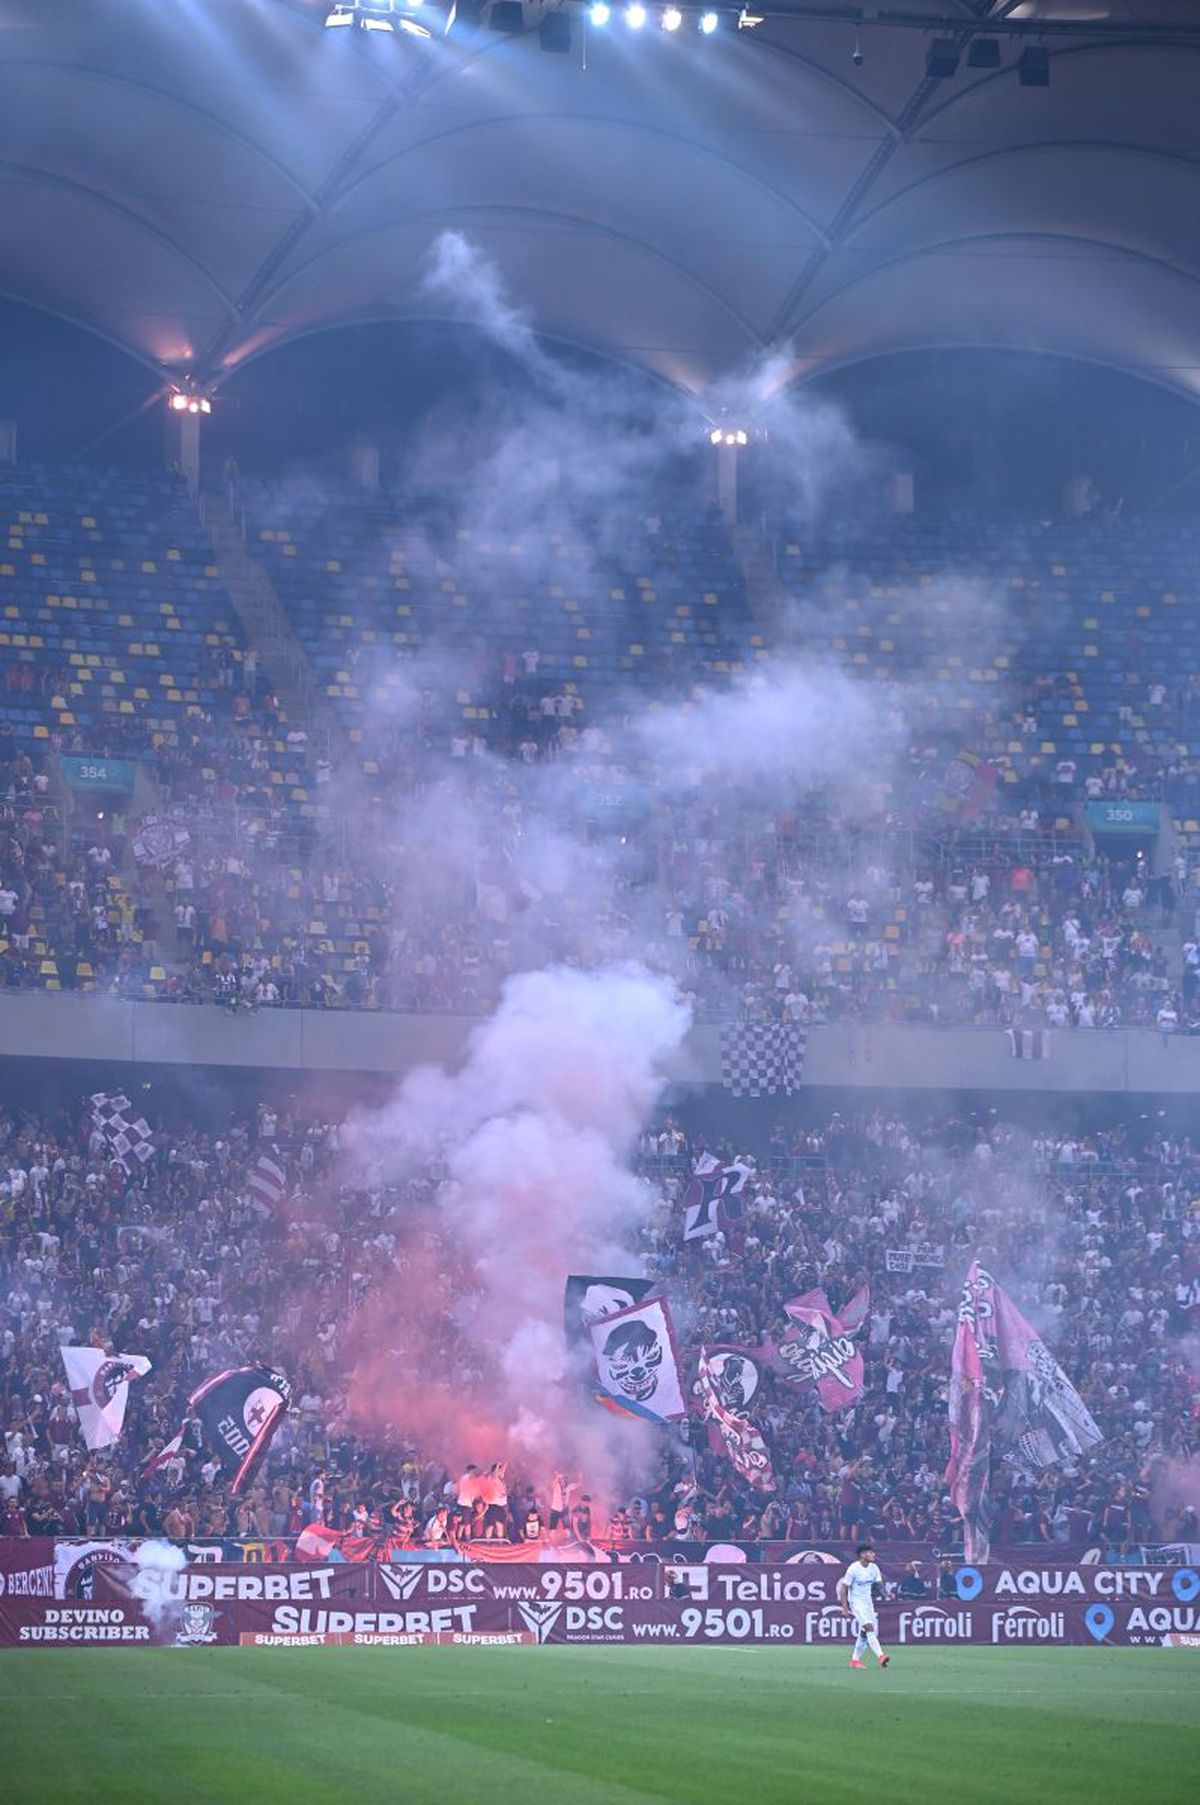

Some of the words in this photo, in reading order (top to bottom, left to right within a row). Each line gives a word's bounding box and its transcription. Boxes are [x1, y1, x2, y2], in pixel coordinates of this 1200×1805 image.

[1106, 809, 1133, 821] 350
[8, 1565, 53, 1597] BERCENI
[132, 1568, 335, 1600] SUPERBET
[428, 1569, 485, 1593] DSC
[717, 1572, 826, 1601] Telios
[994, 1570, 1087, 1595] AQUA
[1094, 1571, 1163, 1595] CITY
[45, 1609, 125, 1623] DEVINO
[272, 1604, 477, 1632] SUPERBET
[566, 1606, 624, 1630] DSC
[1126, 1607, 1200, 1631] AQU
[19, 1625, 150, 1640] SUBSCRIBER
[254, 1634, 326, 1646] SUPERBET
[354, 1633, 425, 1645] SUPERBET
[453, 1633, 523, 1645] SUPERBET
